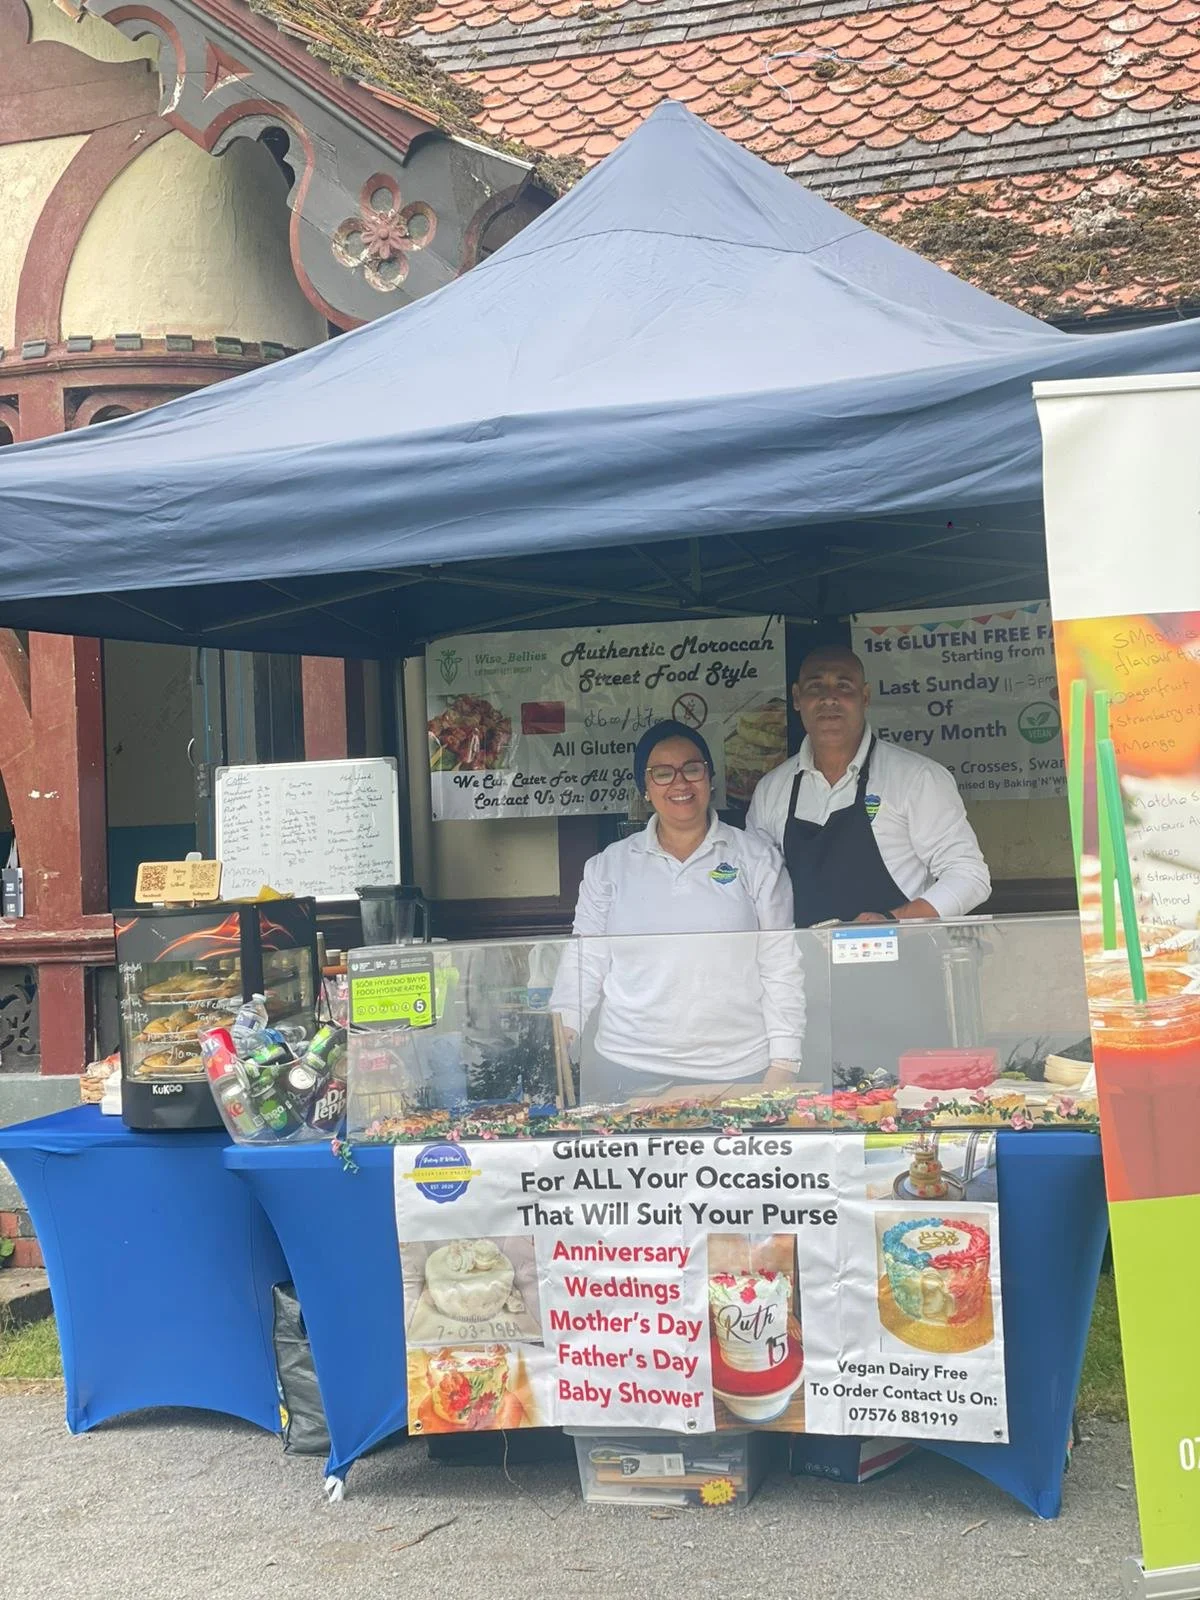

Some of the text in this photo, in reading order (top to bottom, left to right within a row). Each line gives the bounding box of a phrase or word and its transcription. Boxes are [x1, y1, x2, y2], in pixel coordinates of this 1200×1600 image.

[560, 635, 774, 667] Authentic Moroccan
[864, 638, 892, 653] 1st
[897, 630, 977, 651] GLUTEN
[983, 626, 1031, 644] FREE
[941, 648, 1004, 664] Starting
[1007, 644, 1046, 659] from
[579, 660, 758, 693] Street Food Style
[878, 672, 1000, 696] Last Sunday
[927, 699, 954, 717] Of
[878, 720, 1007, 746] Every Month
[552, 740, 637, 757] All Gluten
[453, 775, 479, 789] We
[512, 773, 548, 788] Cater
[550, 771, 578, 787] For
[580, 769, 608, 786] All
[612, 768, 634, 787] Yo
[960, 760, 1023, 774] Crosses,
[988, 779, 1001, 790] By
[474, 792, 529, 809] Contact
[589, 788, 630, 803] 0798
[1151, 891, 1190, 906] Almond
[416, 1000, 424, 1011] 5
[312, 1098, 346, 1124] Pepp
[552, 1136, 793, 1160] Gluten Free Cakes
[521, 1166, 830, 1192] For ALL Your Occasions
[517, 1202, 838, 1226] That Will Suit Your Purse
[552, 1240, 691, 1268] Anniversary
[564, 1276, 680, 1306] Weddings
[550, 1309, 703, 1342] Mother's Day
[717, 1303, 778, 1344] Ruth
[558, 1343, 699, 1378] Father's Day
[766, 1333, 787, 1366] 15
[836, 1359, 968, 1381] Vegan Dairy Free
[558, 1379, 704, 1408] Baby Shower
[810, 1382, 998, 1407] To Order Contact Us On:
[849, 1406, 958, 1427] 07576 881919
